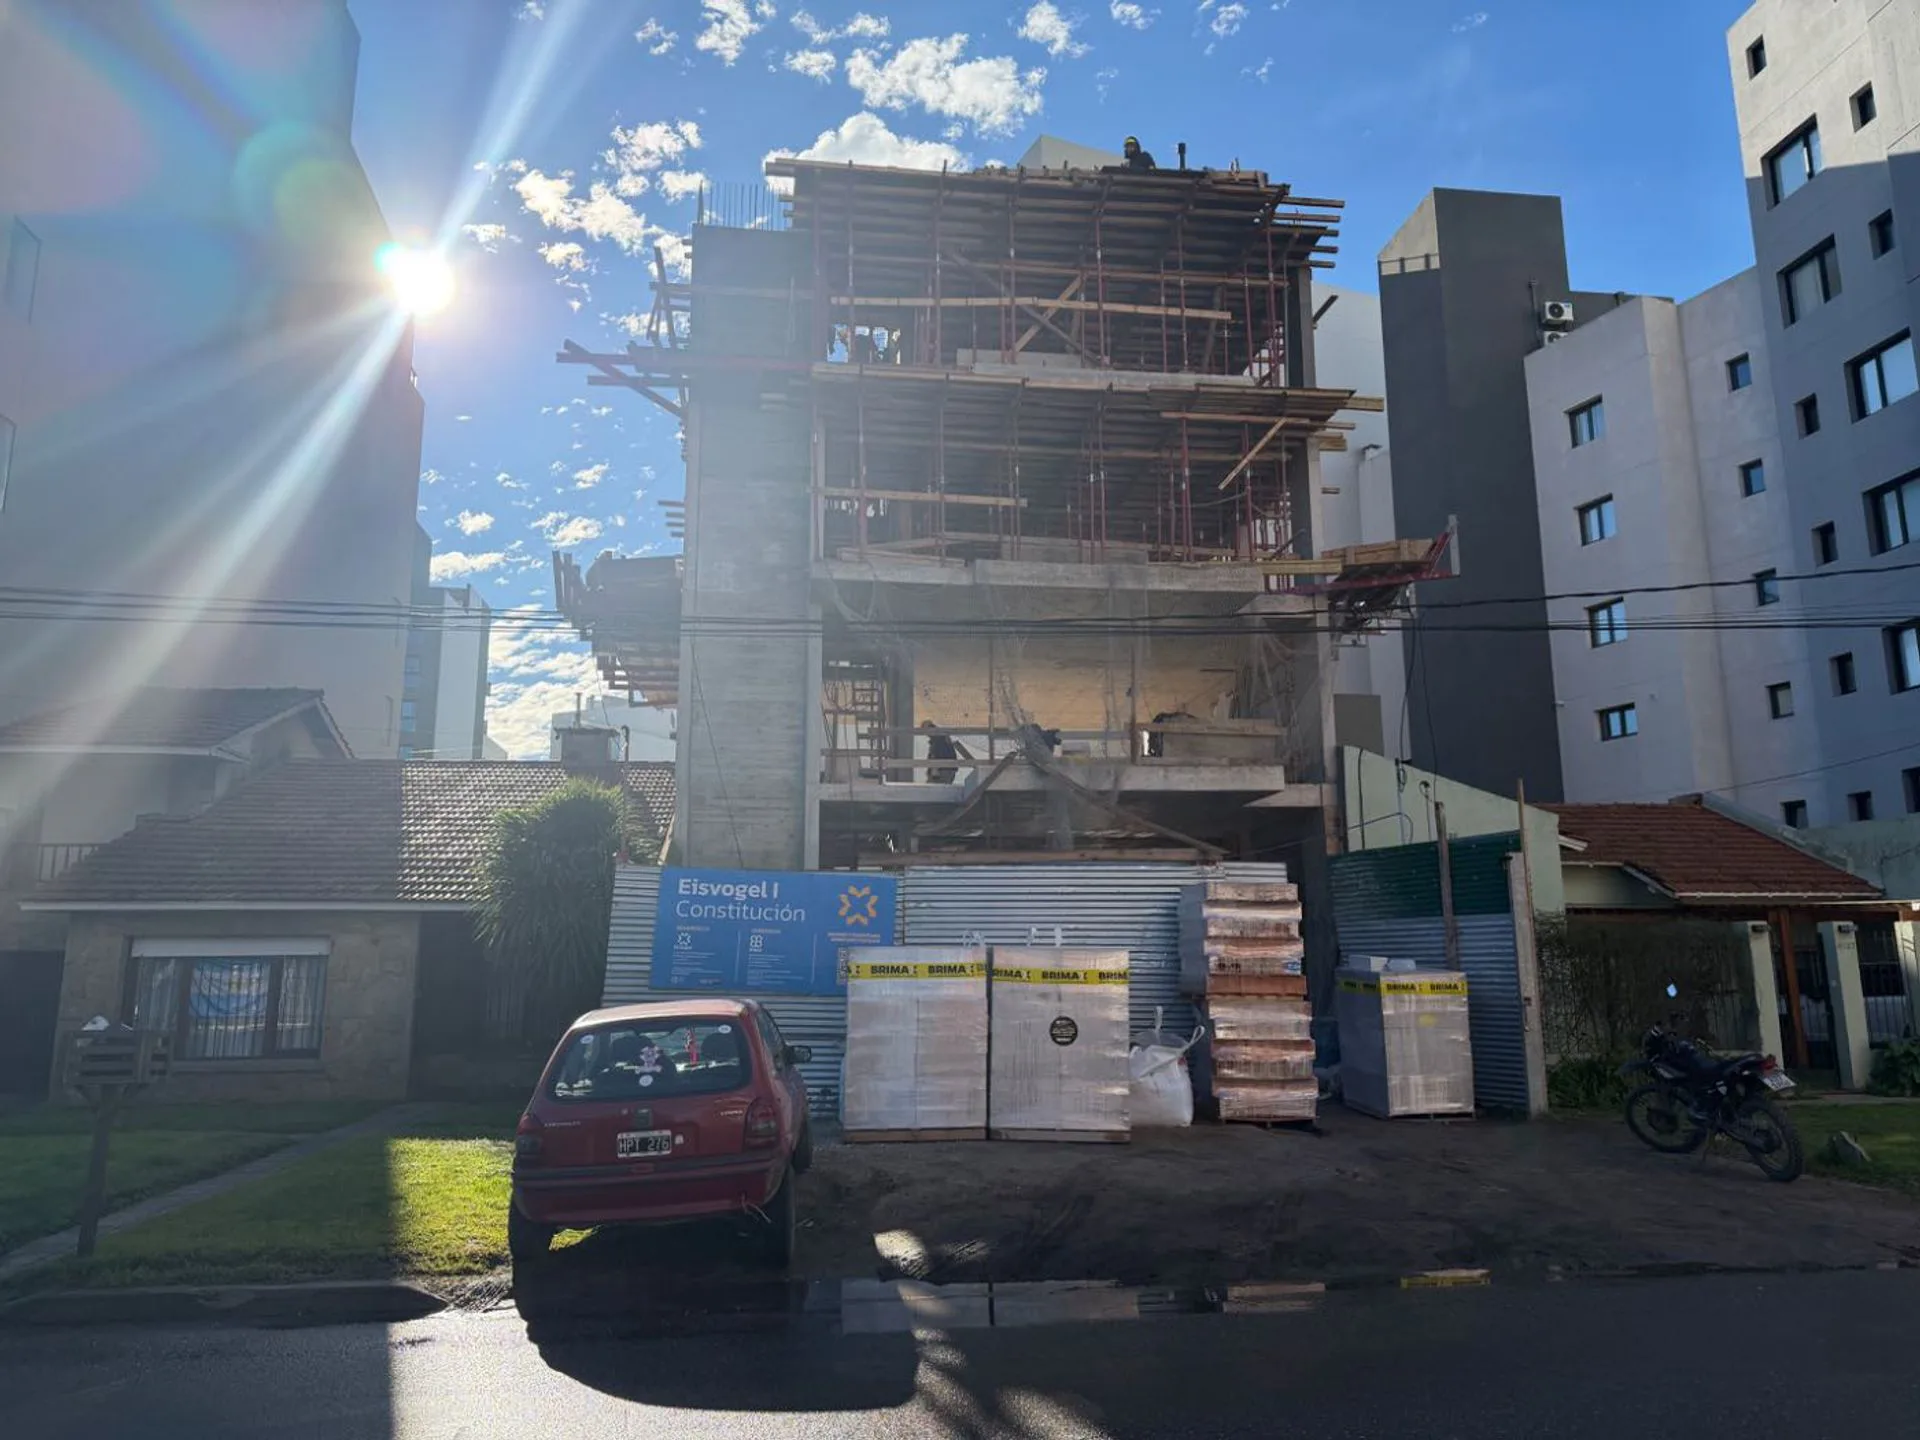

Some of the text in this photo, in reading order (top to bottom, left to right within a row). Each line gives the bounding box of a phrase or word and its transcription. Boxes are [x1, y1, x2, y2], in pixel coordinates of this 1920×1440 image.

[678, 878, 767, 900] Eisvogel
[676, 900, 806, 922] Constitución
[870, 965, 910, 974] BRIMA
[928, 964, 966, 974] BRIMA
[1041, 971, 1079, 980] BRIMA
